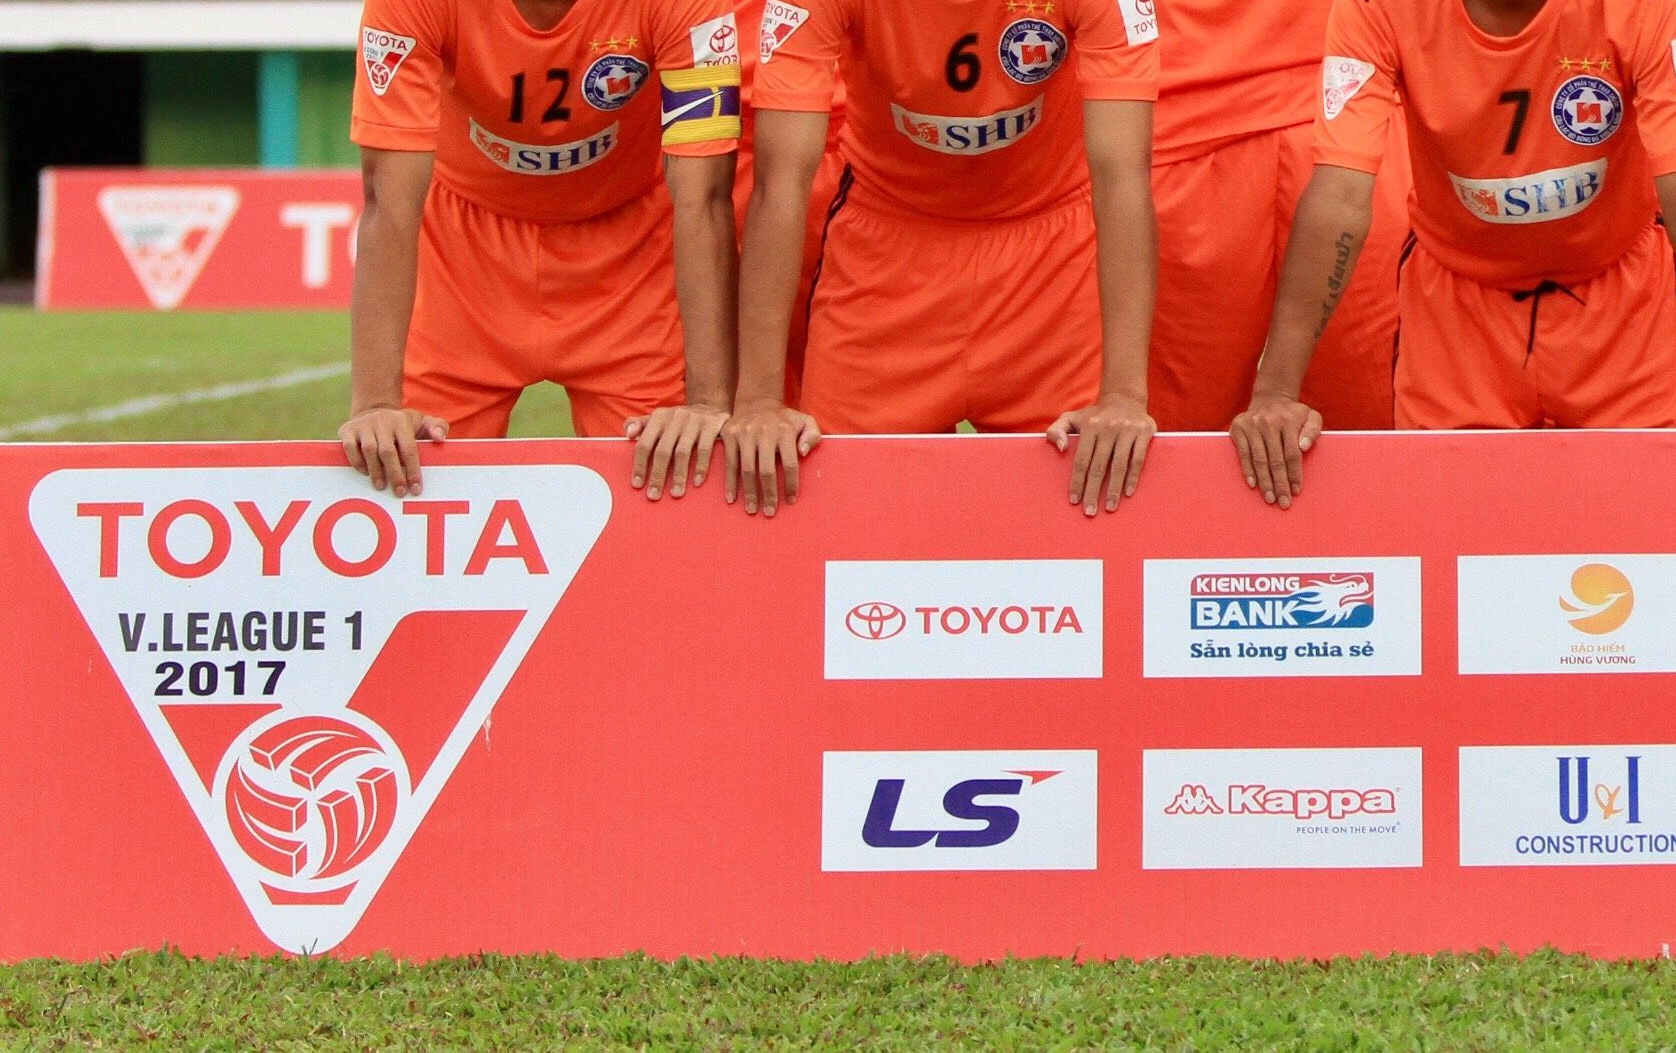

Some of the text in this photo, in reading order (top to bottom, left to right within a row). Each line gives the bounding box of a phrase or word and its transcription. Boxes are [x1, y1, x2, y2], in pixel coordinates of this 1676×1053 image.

[944, 32, 982, 93] 6
[506, 70, 571, 124] 12
[945, 106, 1037, 150] SHB
[1500, 89, 1530, 155] 7
[516, 132, 613, 171] SHB
[1505, 171, 1600, 217] SHB
[77, 498, 550, 578] TOYOTA
[1196, 576, 1299, 593] KIENLONG
[119, 611, 364, 653] V.LEAGUE 1
[916, 605, 1083, 635] TOYOTA
[1196, 600, 1299, 626] BANK
[1190, 640, 1374, 661] Sẵn lòng chia sẻ
[154, 660, 287, 697] 2017
[862, 778, 1024, 848] LS
[1228, 784, 1396, 819] Kappa
[1297, 825, 1397, 834] PEOPLE ON THE MOVE
